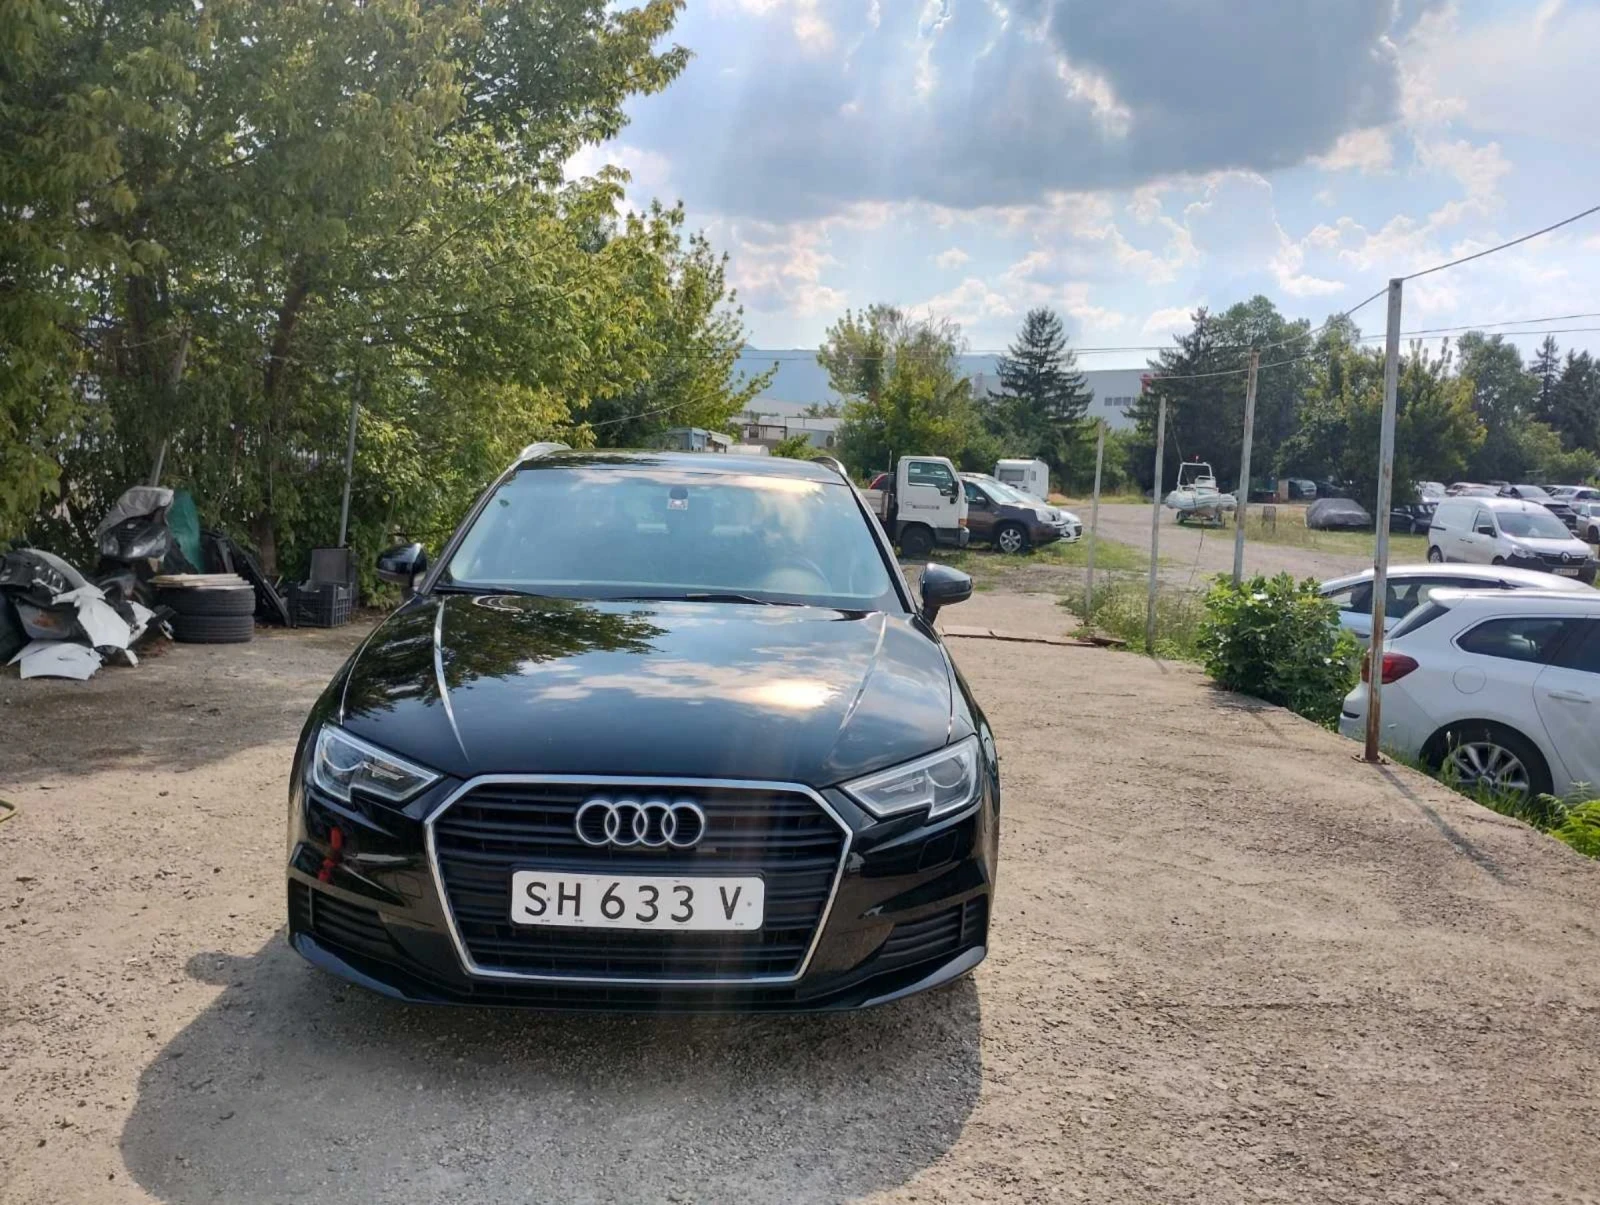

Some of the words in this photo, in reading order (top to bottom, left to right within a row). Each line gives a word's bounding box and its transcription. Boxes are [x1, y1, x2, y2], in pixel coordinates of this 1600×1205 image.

[524, 881, 582, 917] SH
[600, 881, 695, 923] 633
[719, 885, 742, 921] V
